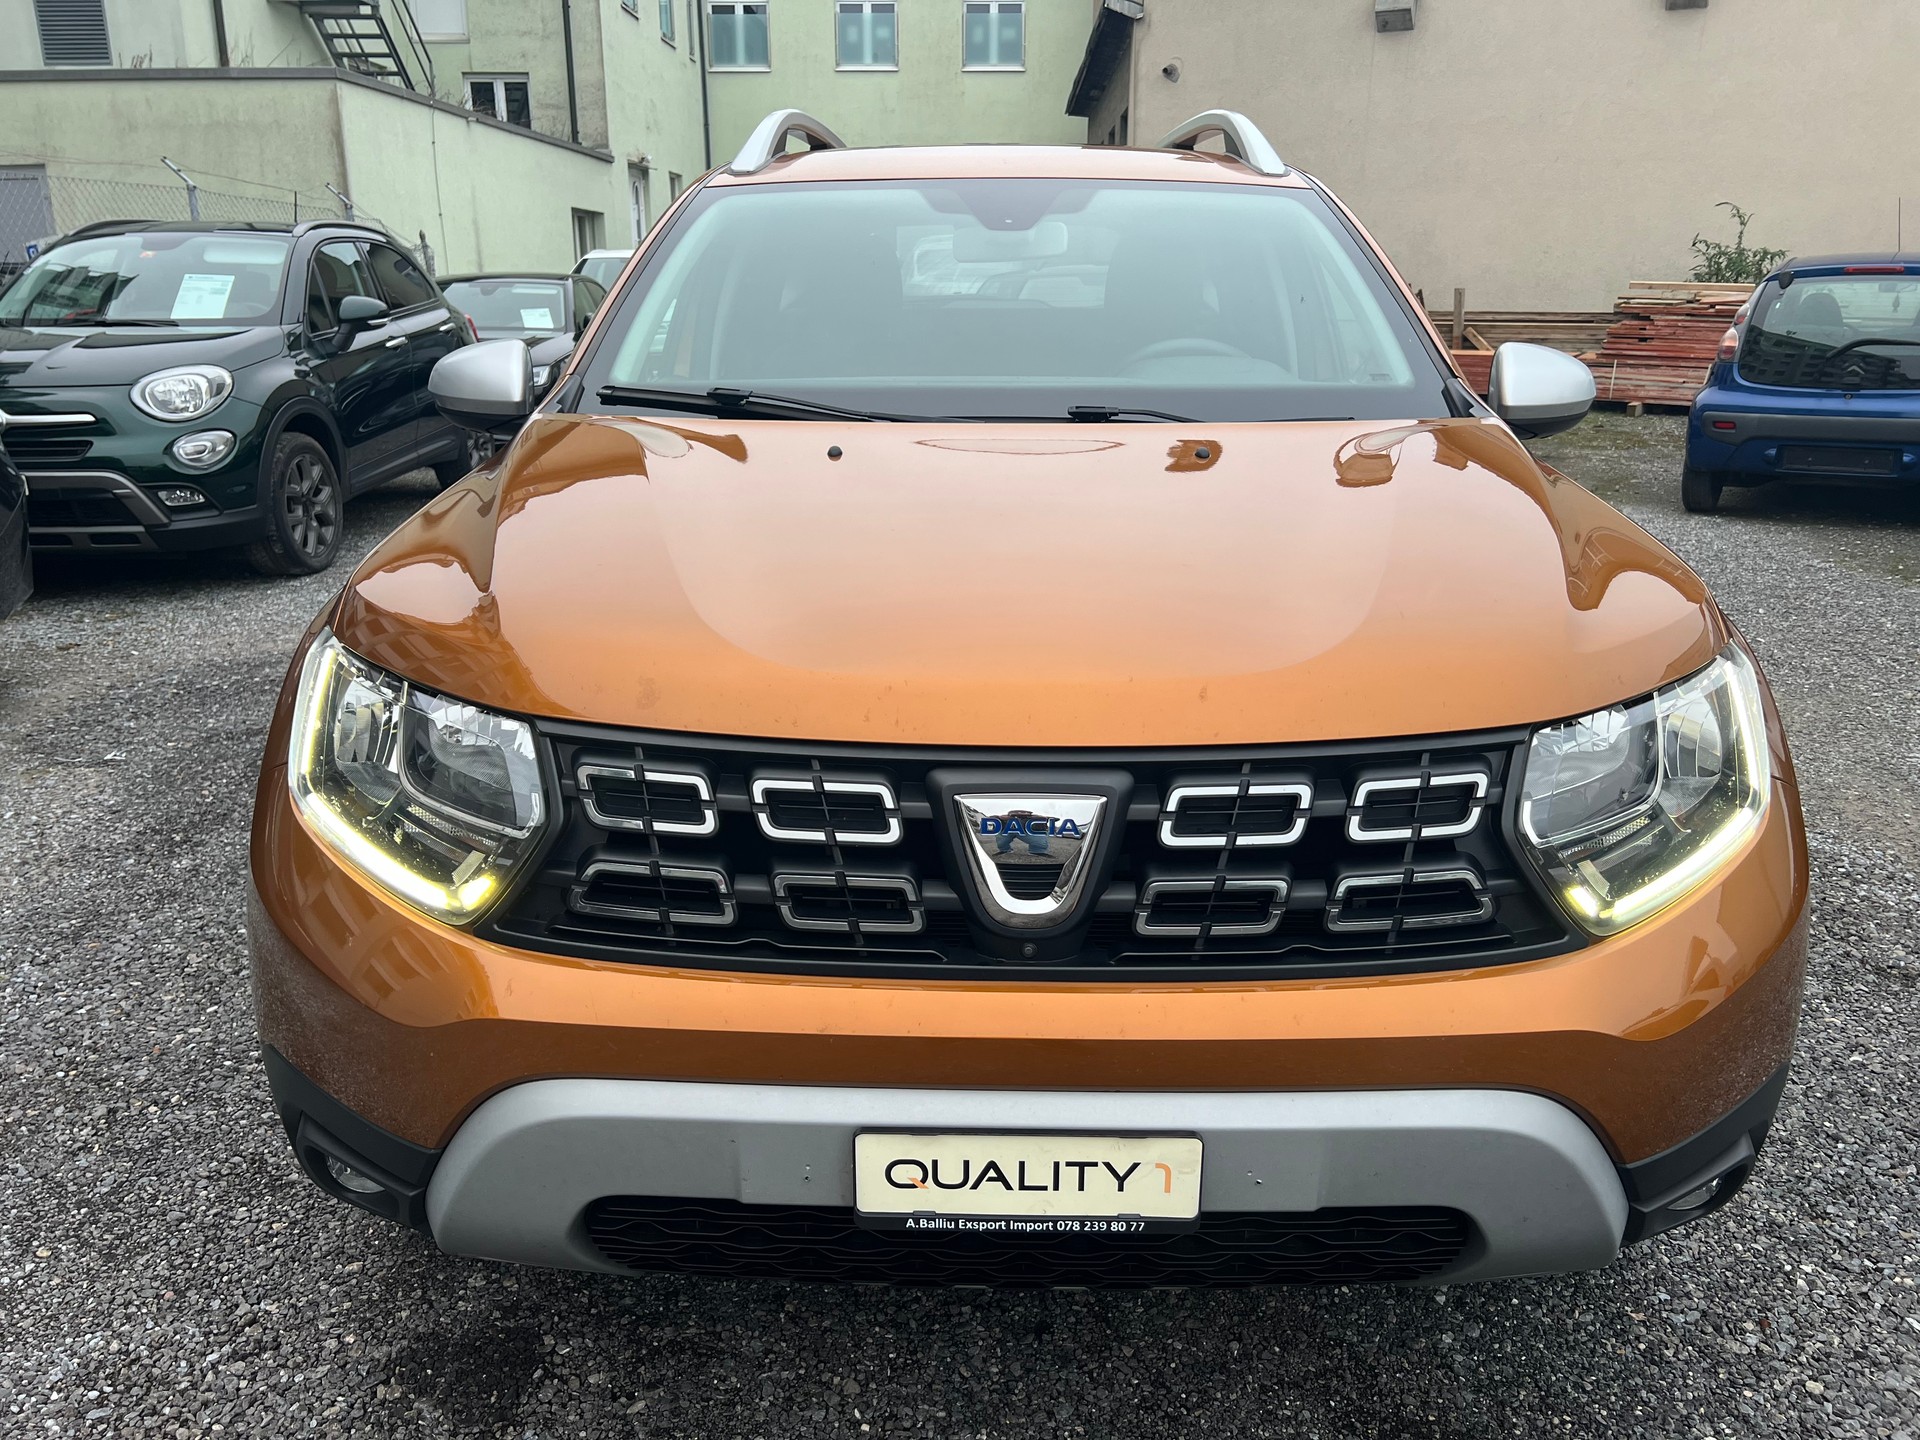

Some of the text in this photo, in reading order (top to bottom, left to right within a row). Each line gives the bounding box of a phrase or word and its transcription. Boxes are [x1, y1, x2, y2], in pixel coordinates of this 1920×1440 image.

[980, 817, 1082, 837] DACIA
[958, 1218, 1006, 1232] Exsport
[1009, 1219, 1054, 1233] Import
[1056, 1220, 1081, 1231] 078
[1083, 1220, 1107, 1231] 239
[1110, 1221, 1127, 1232] 80
[1129, 1221, 1145, 1232] 77
